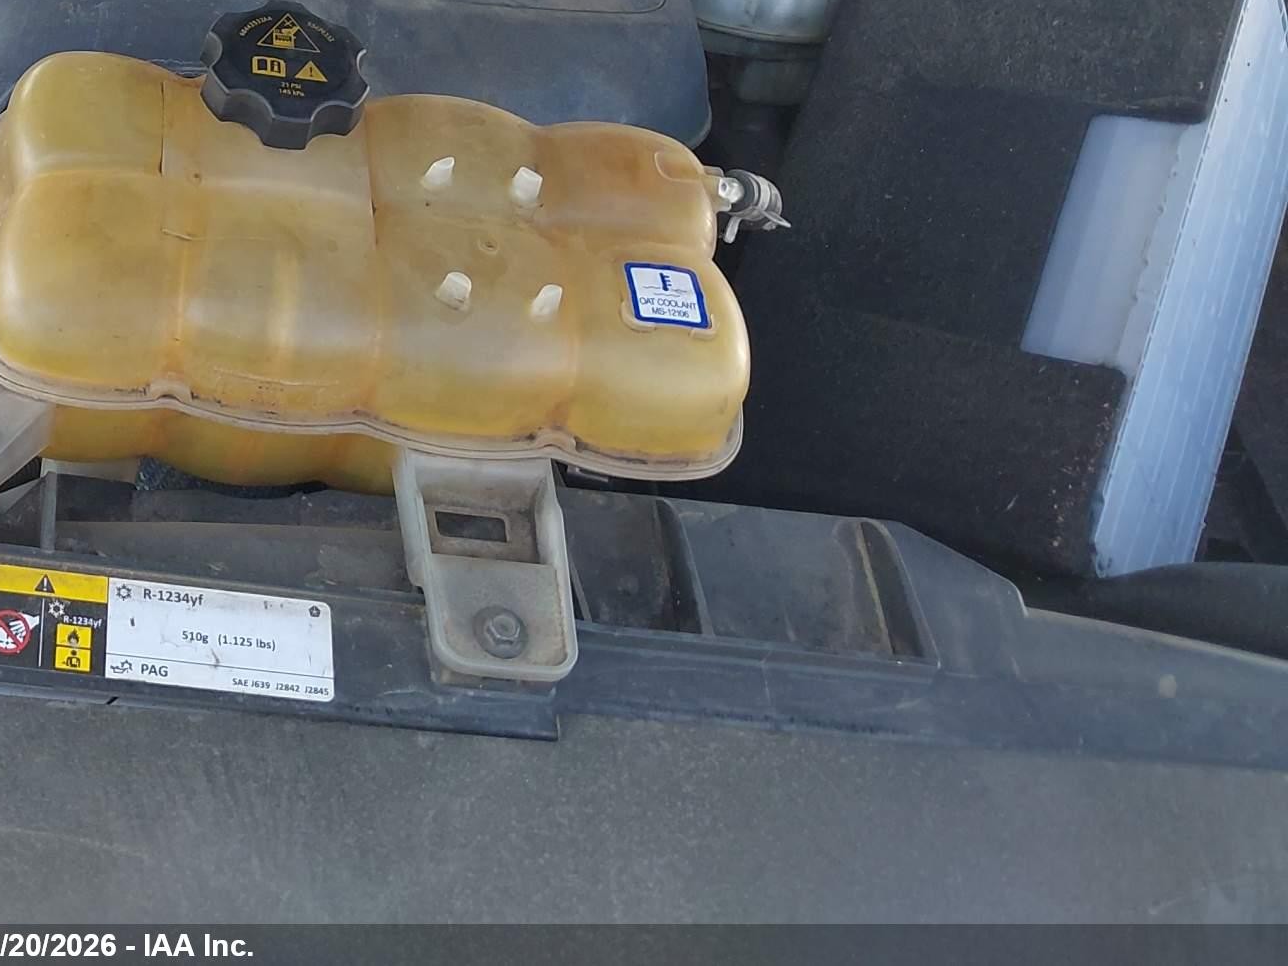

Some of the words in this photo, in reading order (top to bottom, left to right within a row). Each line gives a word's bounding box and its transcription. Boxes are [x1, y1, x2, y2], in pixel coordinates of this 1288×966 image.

[639, 297, 655, 306] OAT
[657, 298, 697, 310] COOLANT
[143, 588, 205, 607] R-1234yf
[63, 615, 103, 629] R-1234yf
[181, 630, 210, 645] 510g
[217, 633, 253, 649] (1.125
[255, 637, 277, 652] lbs)
[140, 663, 169, 678] PAG
[232, 677, 249, 687] SAE
[251, 679, 271, 690] J639
[275, 681, 301, 693] J2842
[304, 685, 330, 697] J2845
